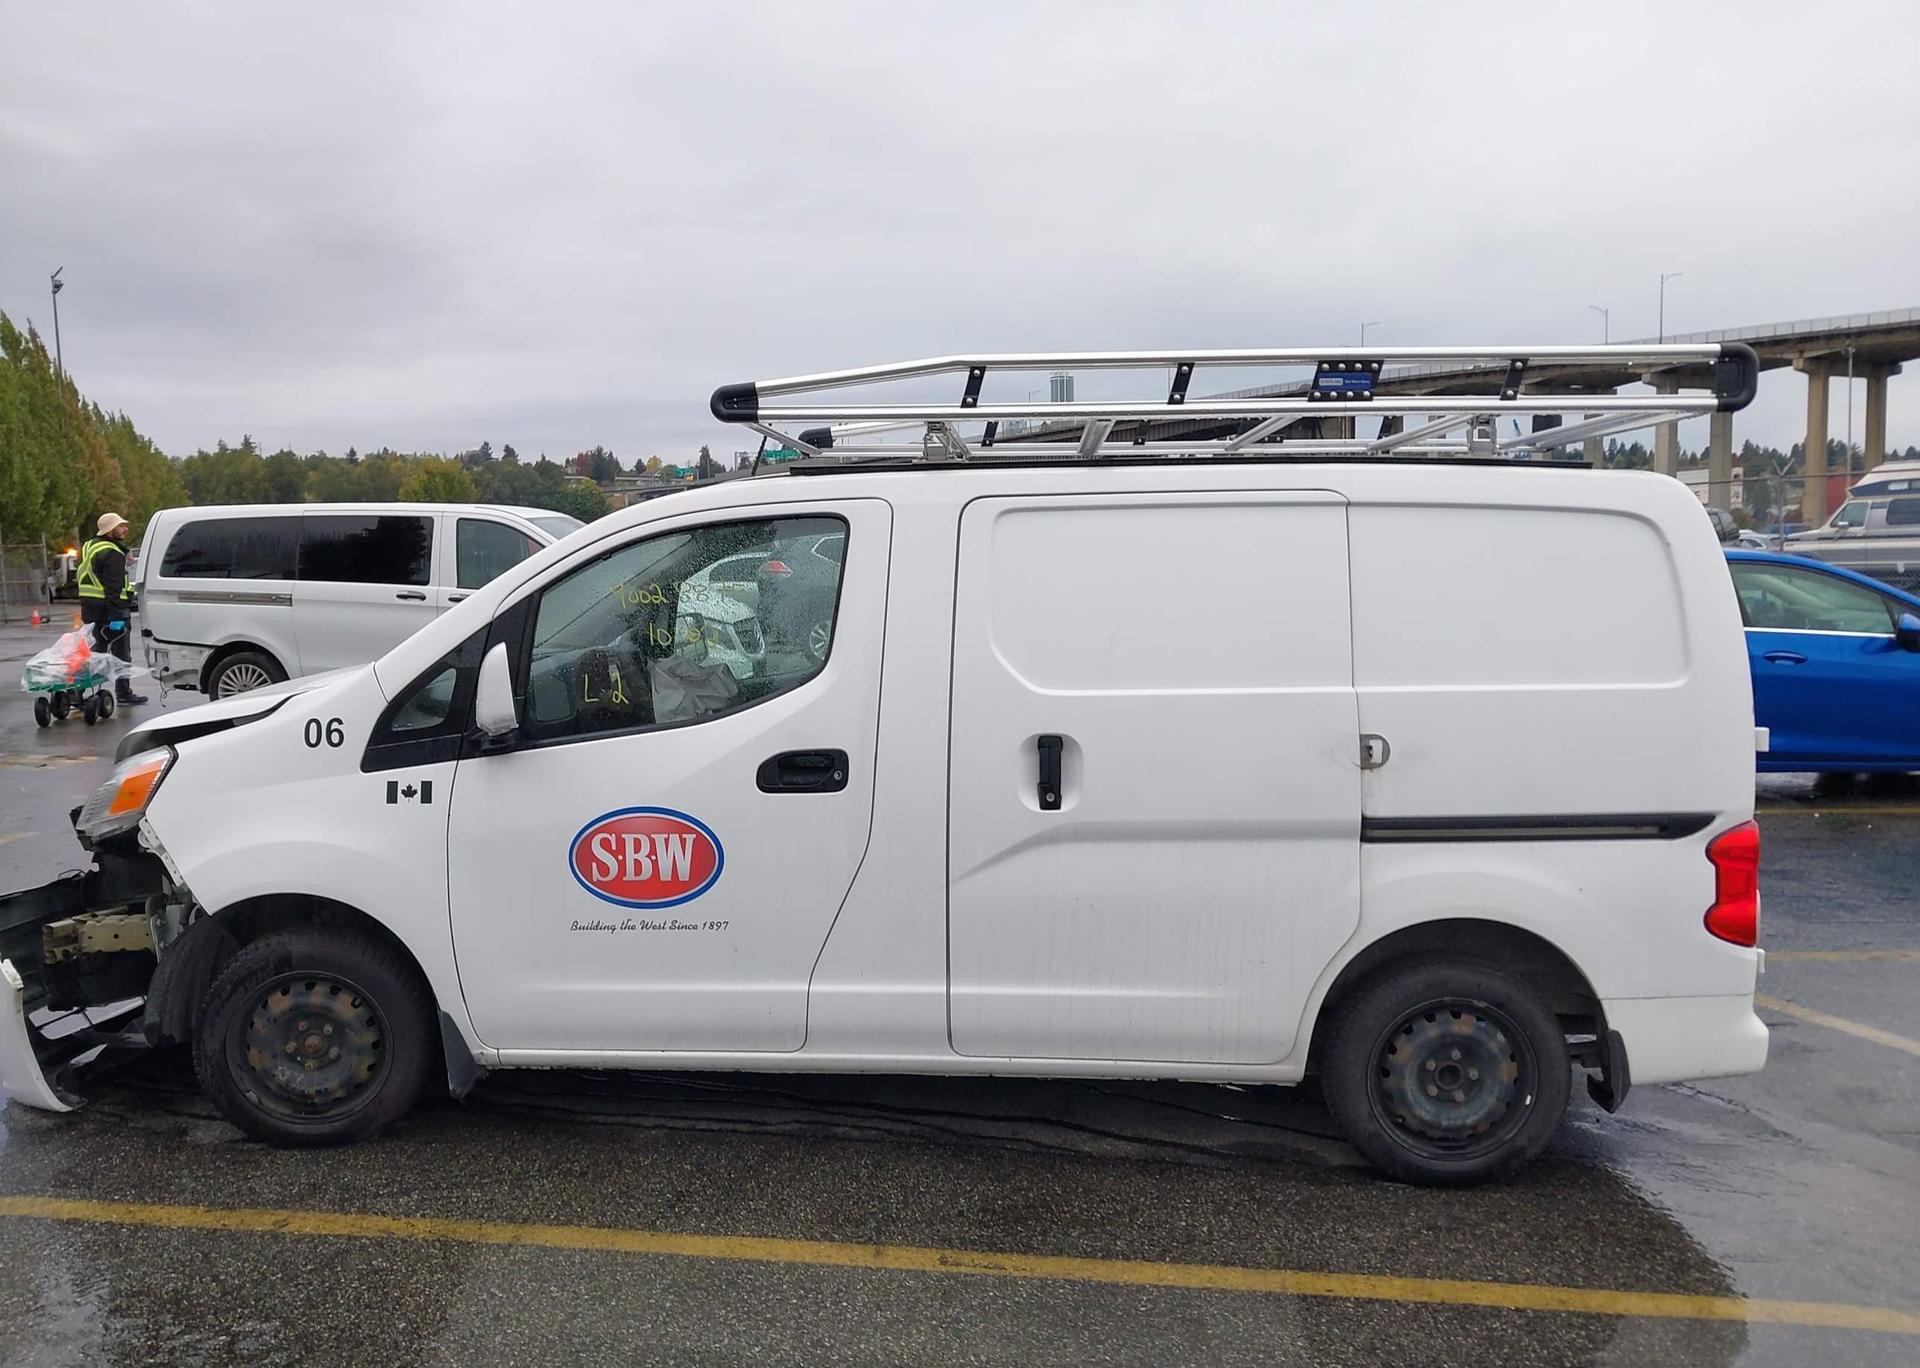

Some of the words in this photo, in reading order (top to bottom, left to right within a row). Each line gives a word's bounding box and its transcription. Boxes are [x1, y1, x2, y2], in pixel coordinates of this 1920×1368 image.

[304, 717, 345, 749] 06
[570, 920, 617, 934] Building
[619, 918, 637, 931] the
[639, 919, 667, 931] West
[668, 919, 699, 931] Since
[702, 920, 730, 932] 1897
